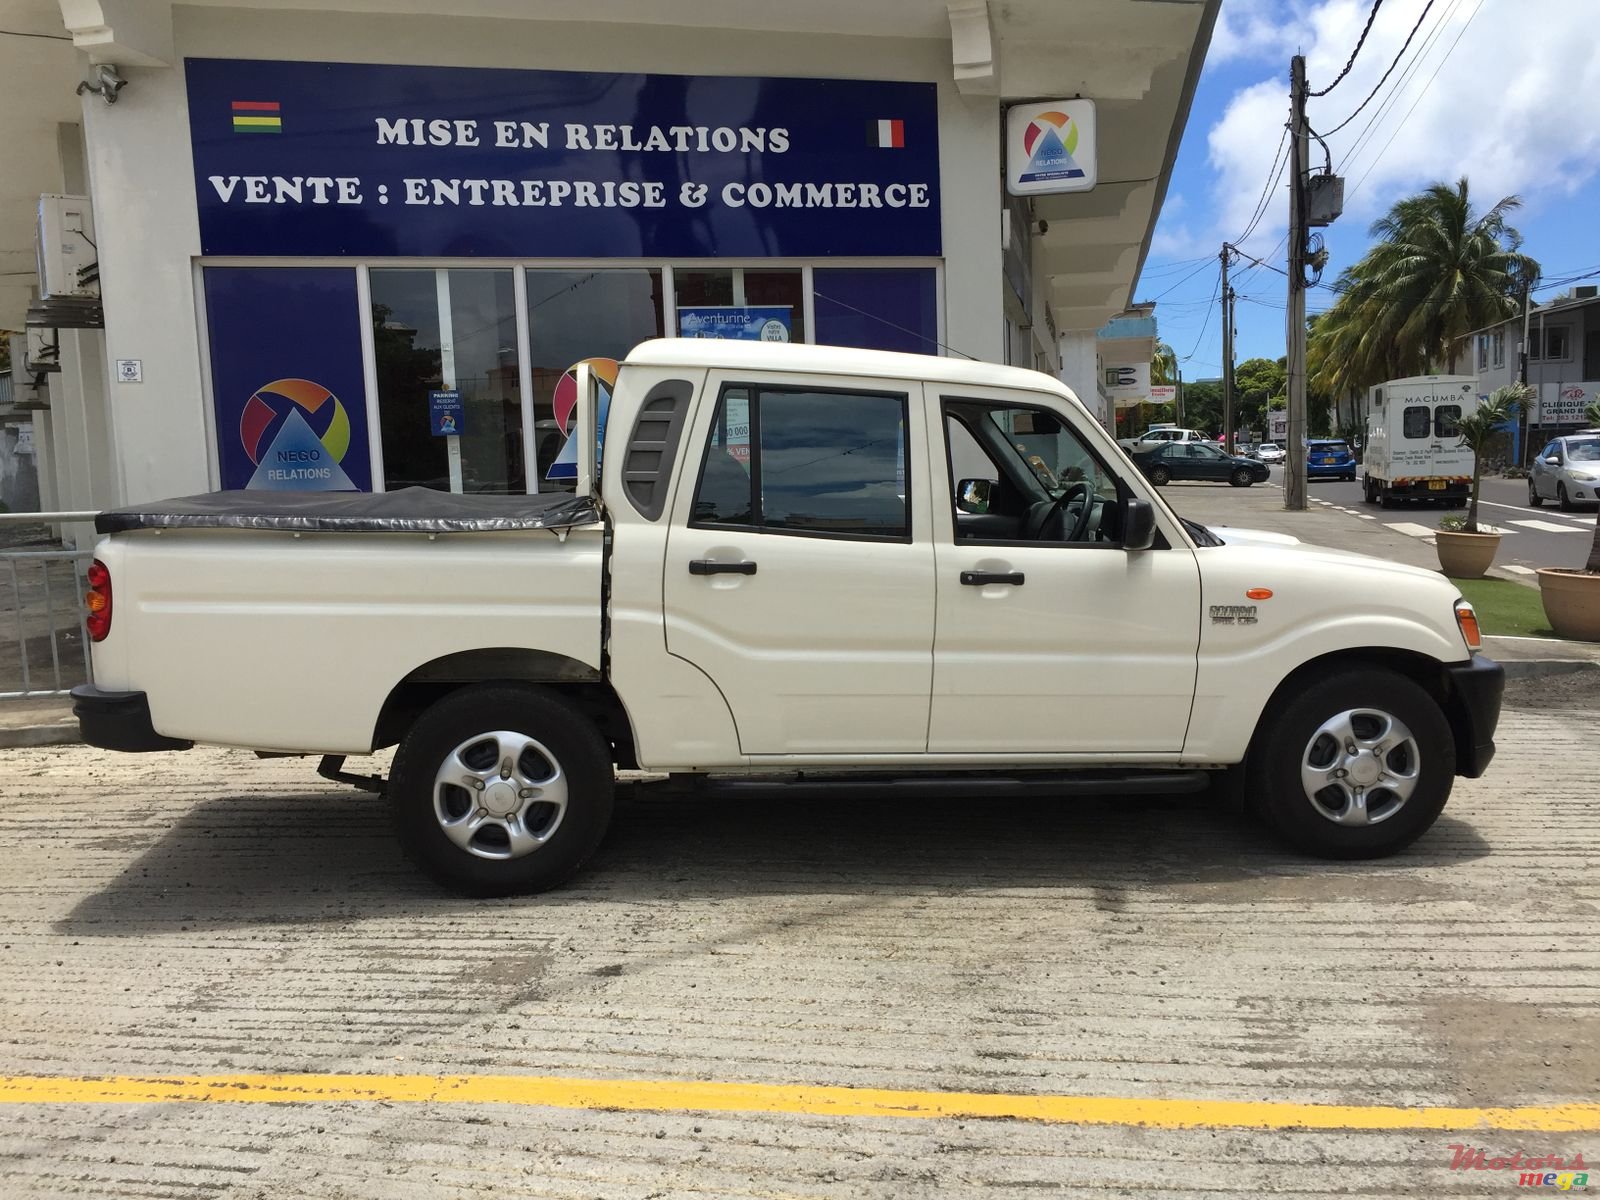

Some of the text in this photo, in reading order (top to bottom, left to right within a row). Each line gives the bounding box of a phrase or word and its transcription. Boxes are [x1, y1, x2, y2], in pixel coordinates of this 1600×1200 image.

[376, 118, 790, 152] MISE EN RELATIONS
[1040, 148, 1063, 157] NEGO
[1035, 158, 1067, 167] RELATIONS
[209, 175, 929, 208] VENTE : ENTREPRISE & COMMERCE
[688, 312, 751, 324] Aventurine
[1404, 393, 1465, 404] MACUMBA
[1542, 400, 1585, 408] CLINIQUE
[277, 449, 321, 463] NEGO
[268, 468, 331, 480] RELATIONS
